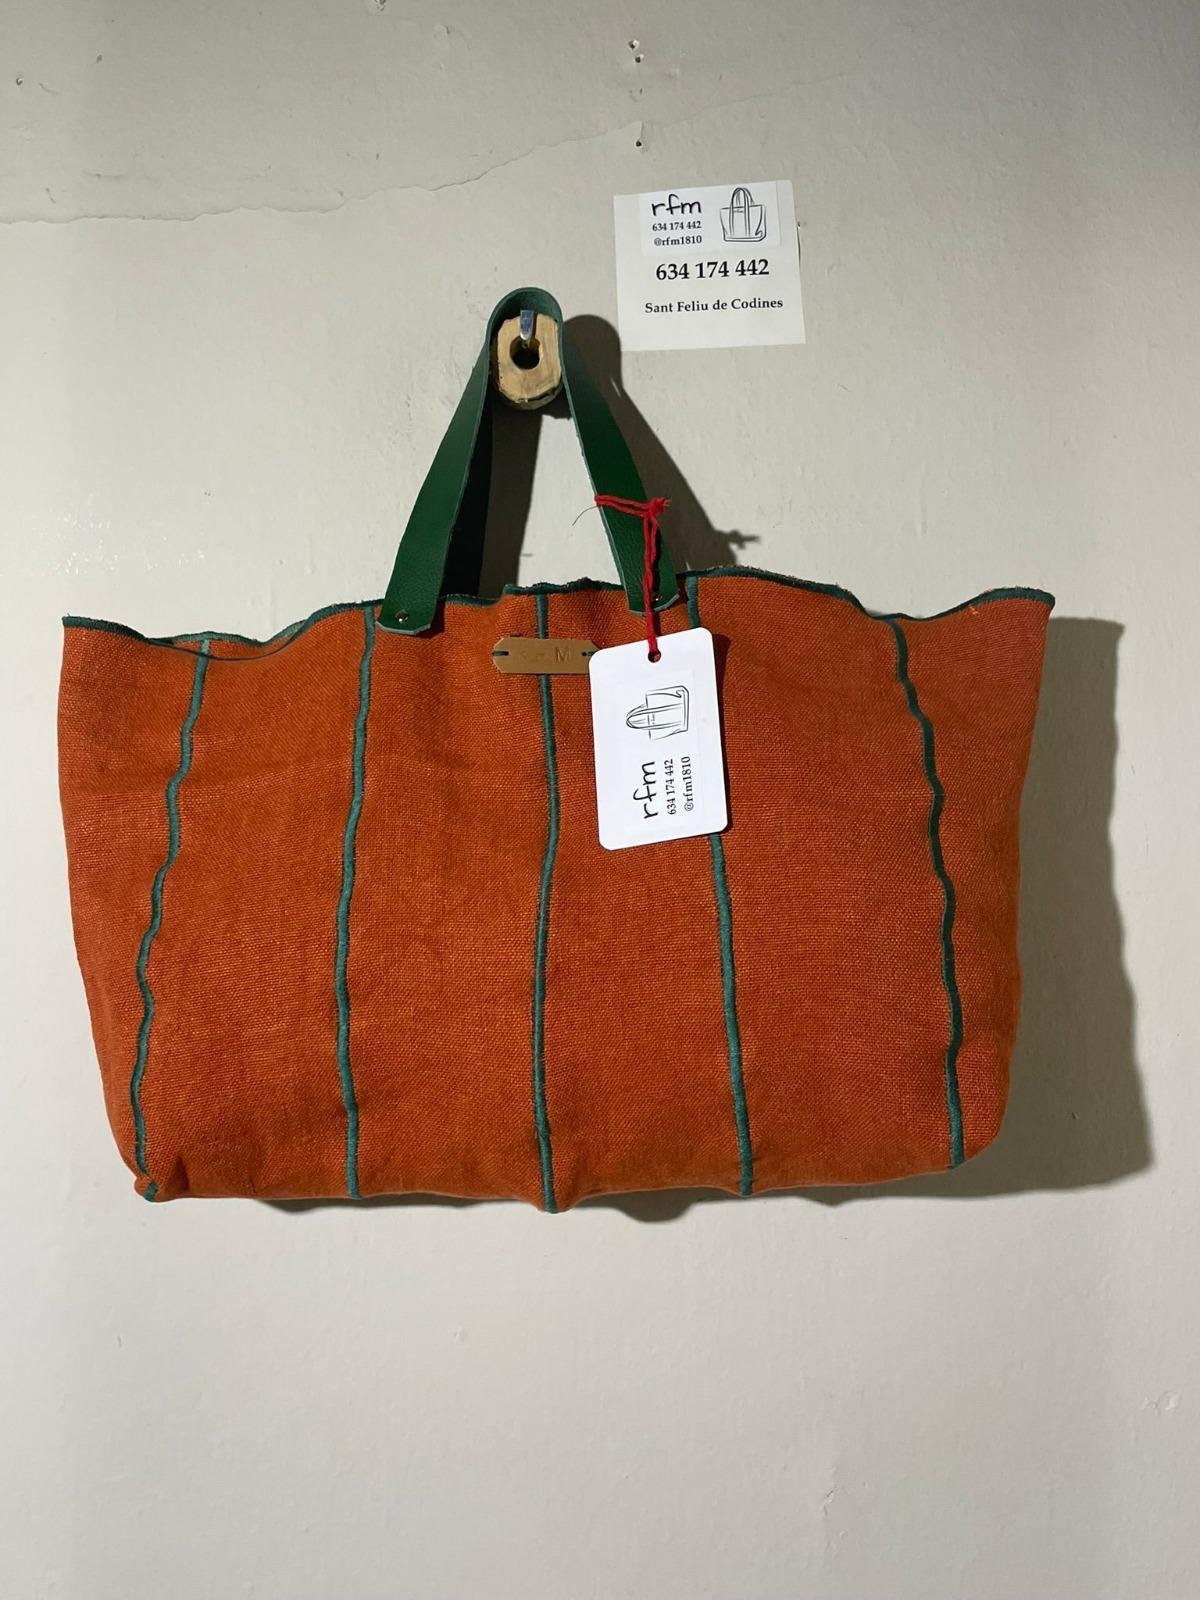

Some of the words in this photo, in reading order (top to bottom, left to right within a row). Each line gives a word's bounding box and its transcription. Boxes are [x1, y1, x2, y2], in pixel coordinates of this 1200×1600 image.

[652, 194, 701, 216] rfm
[652, 223, 667, 231] 634
[670, 222, 684, 230] 174
[686, 221, 701, 229] 442
[654, 235, 702, 246] @rfm1810
[656, 263, 689, 280] 634
[695, 261, 729, 278] 174
[735, 259, 769, 276] 442
[645, 303, 673, 313] Sant
[677, 301, 708, 312] Feliu
[713, 300, 727, 310] de
[731, 298, 783, 309] Codines
[664, 759, 673, 776] 442
[633, 762, 658, 819] rfm
[666, 779, 675, 795] 174
[681, 757, 693, 811] @rfm1810
[667, 798, 676, 815] 634
